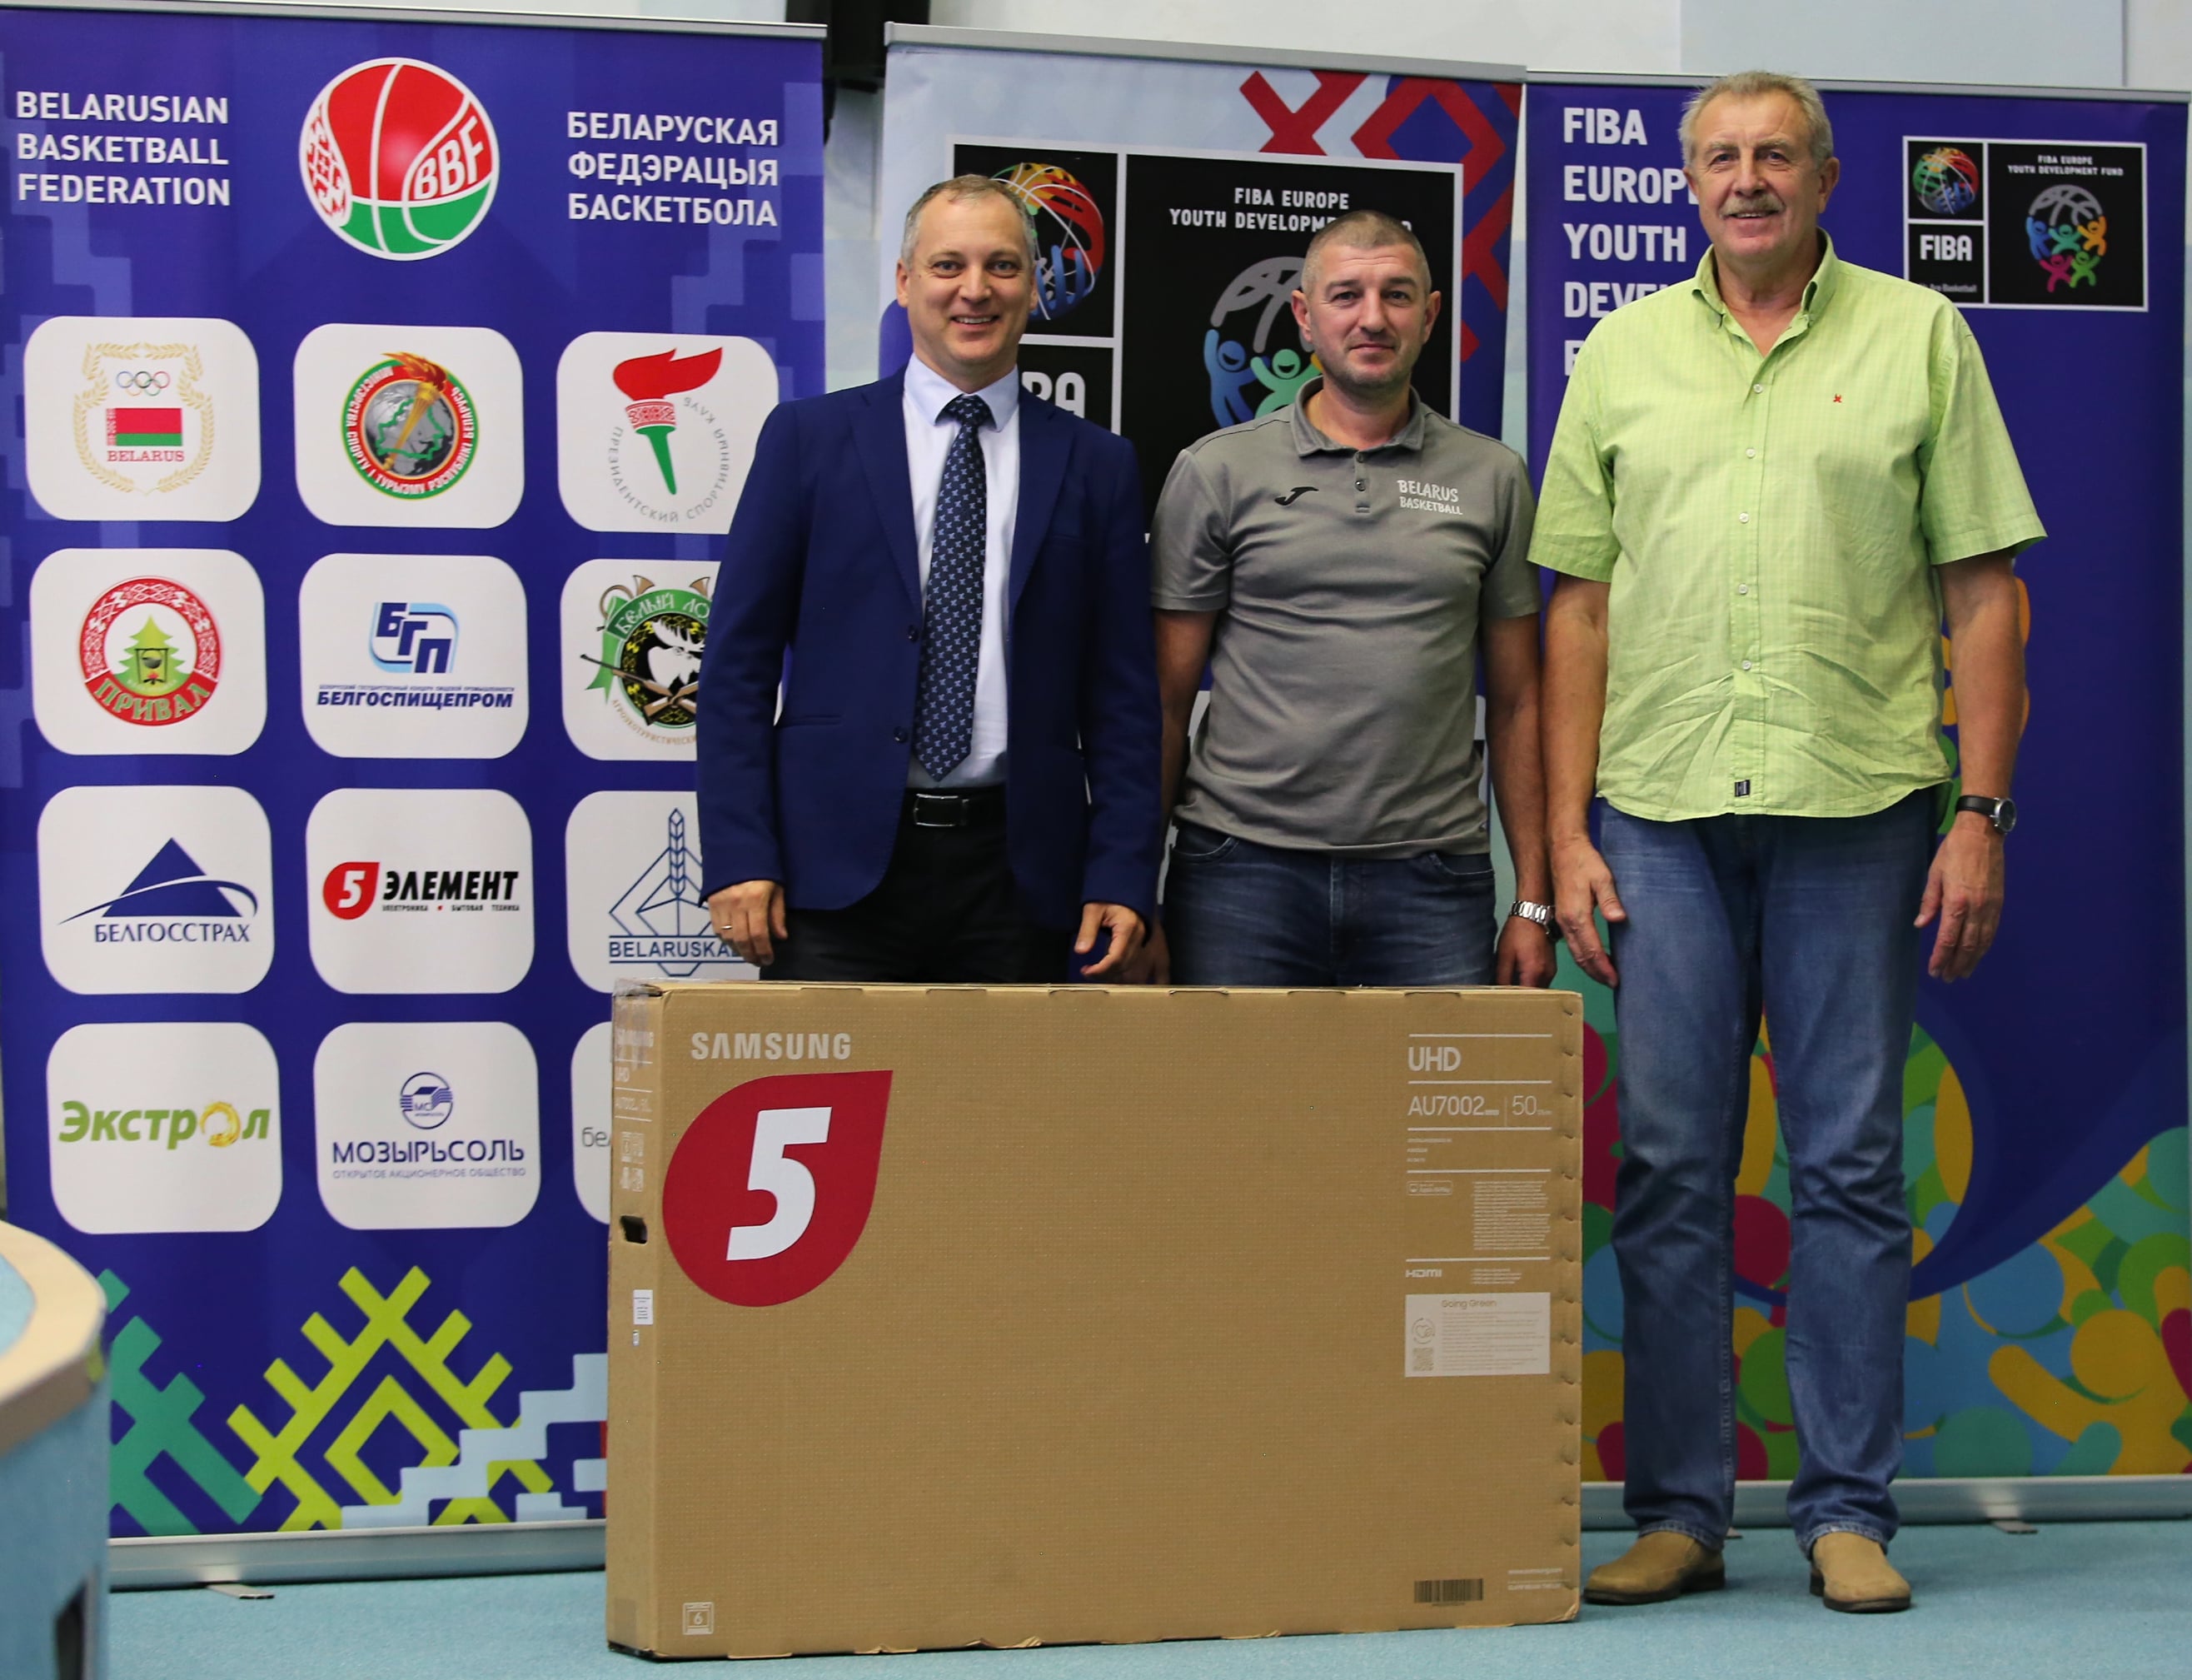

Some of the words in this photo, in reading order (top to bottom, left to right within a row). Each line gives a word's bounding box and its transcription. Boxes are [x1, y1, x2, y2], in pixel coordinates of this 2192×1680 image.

[17, 91, 228, 124] BELARUSIAN
[567, 112, 778, 146] БЕЛАРУСКАЯ
[1563, 107, 1647, 145] FIBA
[17, 133, 228, 165] BASKETBALL
[416, 116, 484, 200] BBF
[2038, 154, 2058, 164] FIBA
[2060, 155, 2093, 165] EUROPE
[568, 151, 778, 189] ФЕДЭРАЦЫЯ
[17, 173, 230, 206] FEDERATION
[1234, 187, 1274, 206] FIBA
[1282, 190, 1349, 209] EUROPE
[568, 193, 778, 227] БАСКЕТБОЛА
[1169, 208, 1227, 227] YOUTH
[1235, 212, 1336, 232] DEVELOPM
[1562, 223, 1686, 262] YOUTH
[1920, 234, 1972, 262] FIBA
[683, 396, 715, 424] КЛУБ
[107, 450, 185, 461] BELARUS
[1397, 480, 1459, 502] BELARUS
[1399, 496, 1463, 515] BASKETBALL
[683, 598, 710, 618] ЛО
[376, 602, 451, 673] БГП
[94, 678, 210, 721] ПРИВАЛ
[317, 691, 513, 710] БЕЛГОСПИЩЕПРОМ
[338, 870, 366, 909] 5
[383, 870, 519, 900] ЭЛЕМЕНТ
[94, 923, 250, 943] БЕЛГОССТРАХ
[690, 1032, 851, 1060] SAMSUNG
[1408, 1046, 1462, 1072] UHD
[1407, 1095, 1485, 1116] AU7002
[1512, 1095, 1537, 1116] 50
[333, 1139, 525, 1164] МОЗЫРЬСОЛЬ
[333, 1169, 387, 1179] ОТКРЫТОЕ
[469, 1167, 526, 1178] ОБЩЕСТВО
[726, 1106, 832, 1261] 5
[1442, 1299, 1467, 1310] Going
[1469, 1299, 1497, 1308] Green
